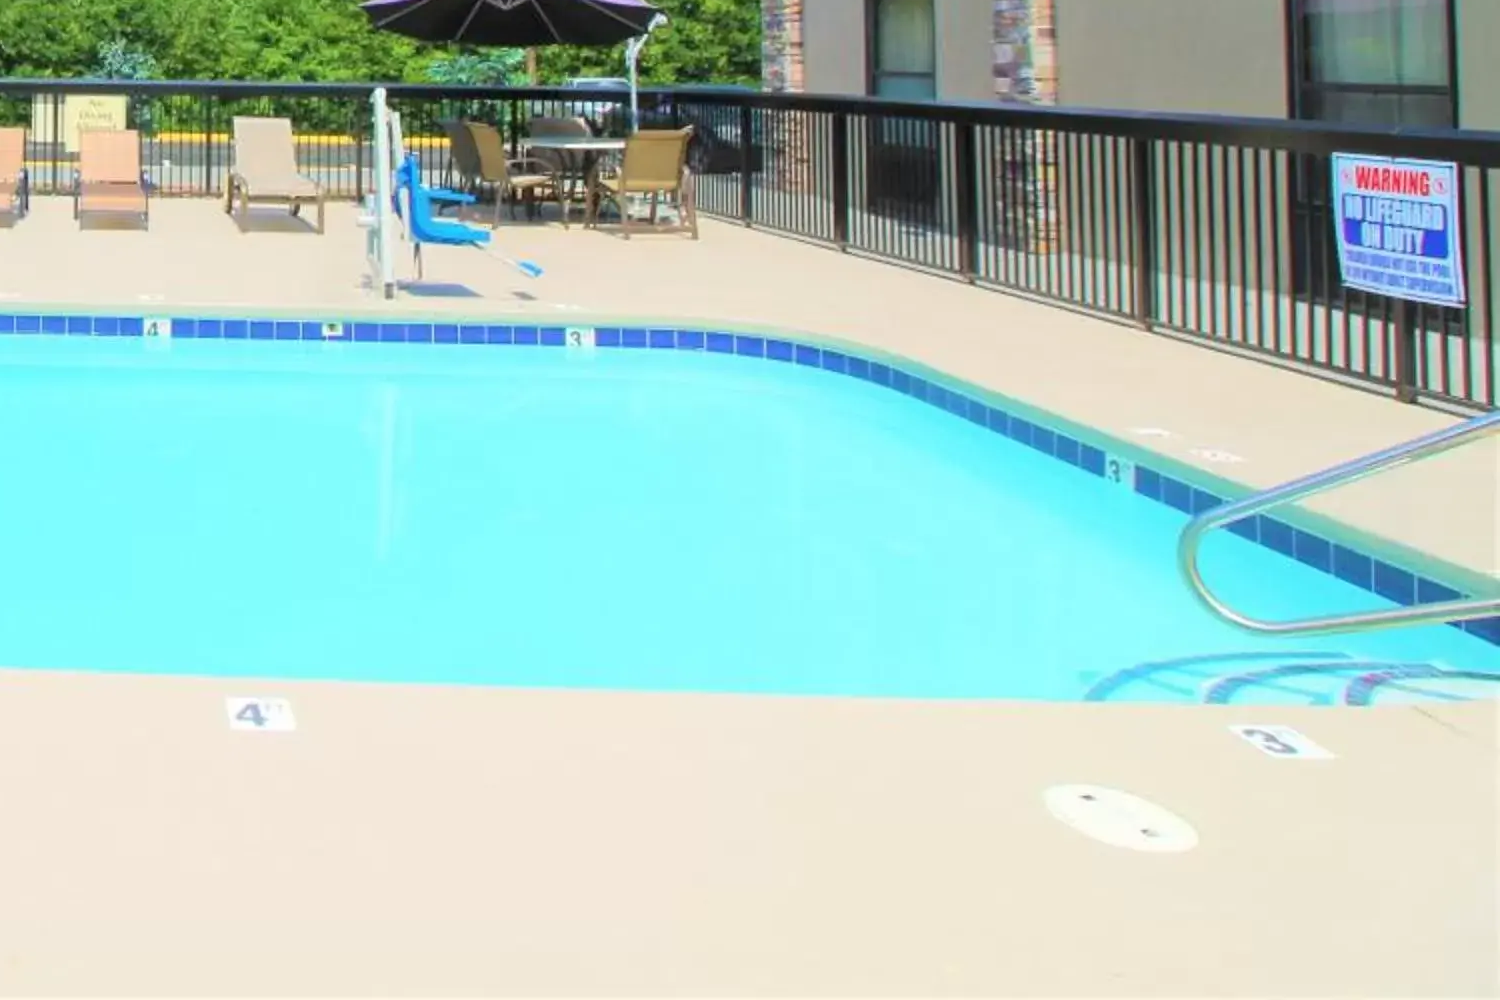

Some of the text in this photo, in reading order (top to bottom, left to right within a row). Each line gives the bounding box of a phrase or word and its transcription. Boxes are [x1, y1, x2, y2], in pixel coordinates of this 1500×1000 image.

[1355, 165, 1430, 197] WARNING
[1361, 222, 1424, 256] ON DUTY
[235, 702, 270, 727] 4
[1241, 728, 1299, 754] 3
